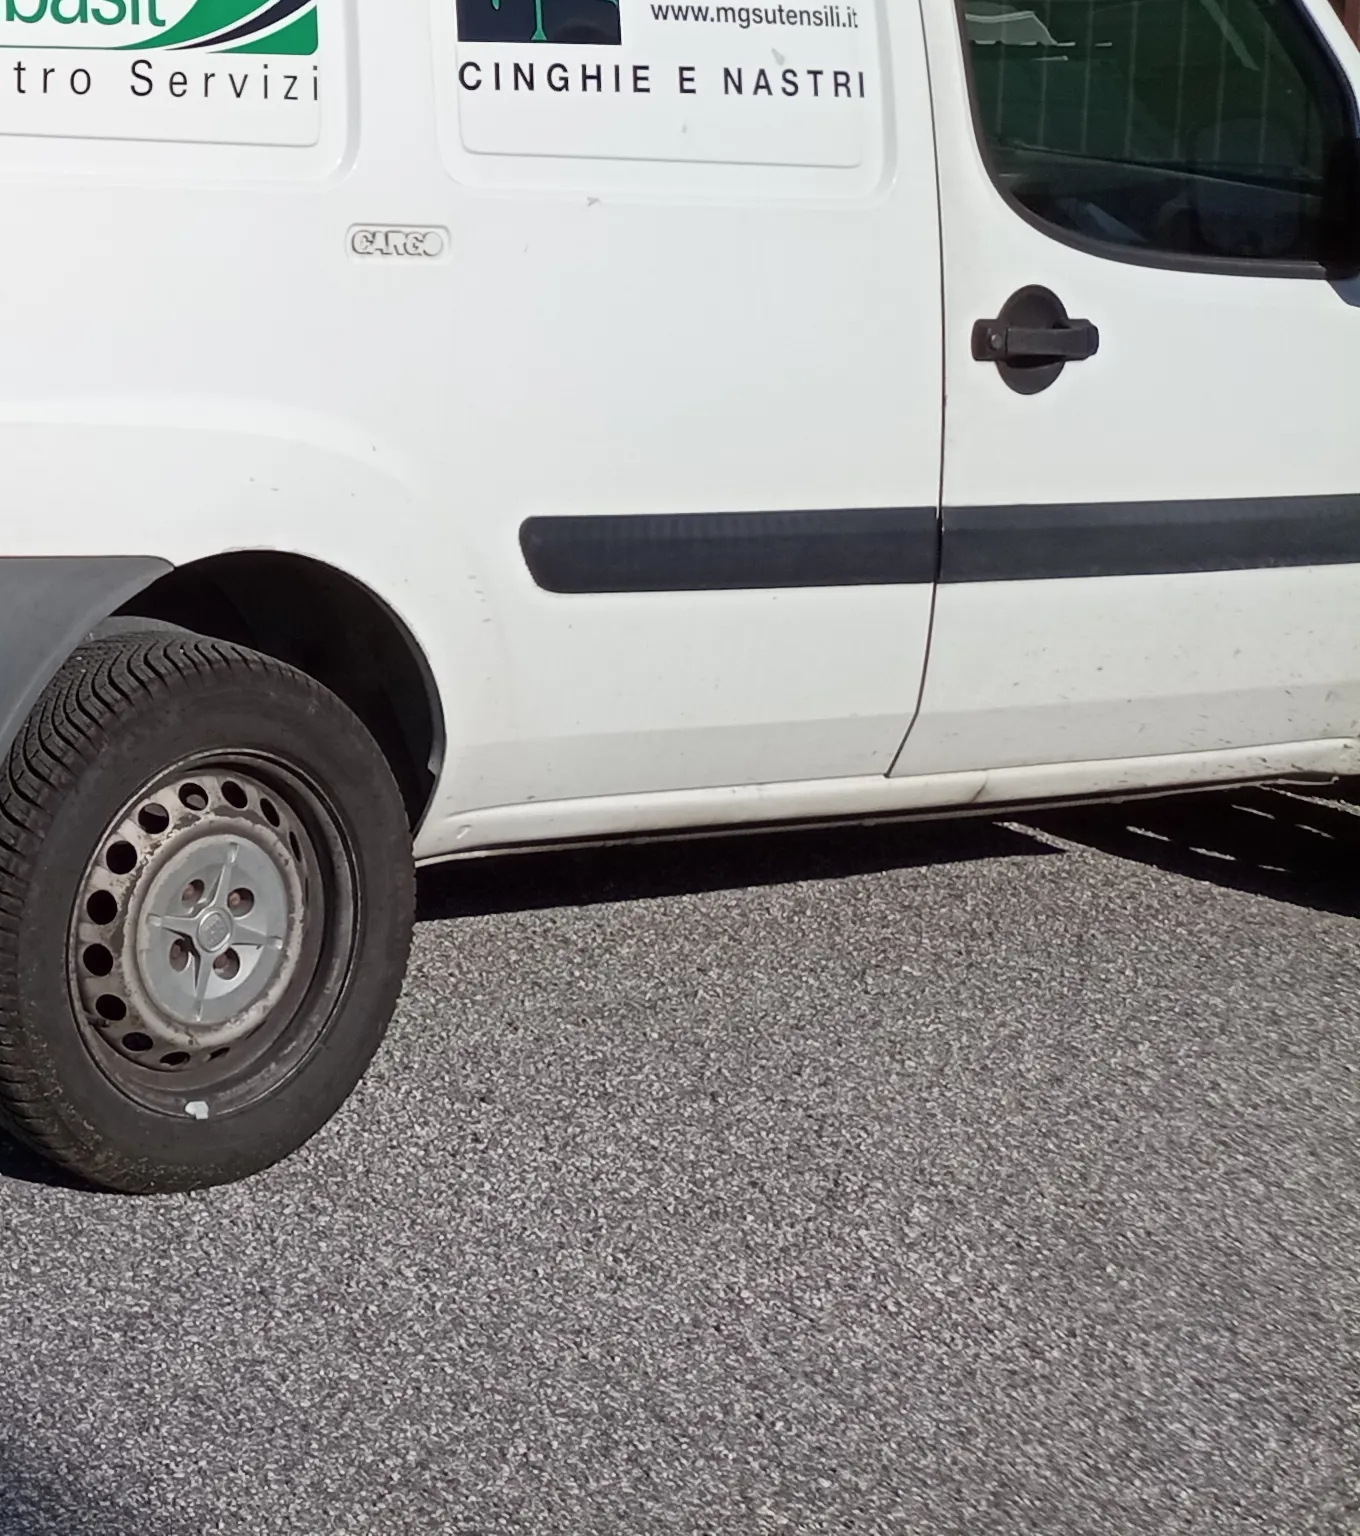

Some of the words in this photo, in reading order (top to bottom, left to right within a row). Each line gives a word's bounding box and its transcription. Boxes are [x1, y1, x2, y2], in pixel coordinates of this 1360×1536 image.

[651, 3, 860, 29] www.mgsutensili.it
[130, 59, 319, 101] Servizi
[458, 61, 651, 93] CINGHIE
[678, 66, 697, 94] E
[723, 67, 866, 98] NASTRI
[351, 229, 444, 257] CARGO
